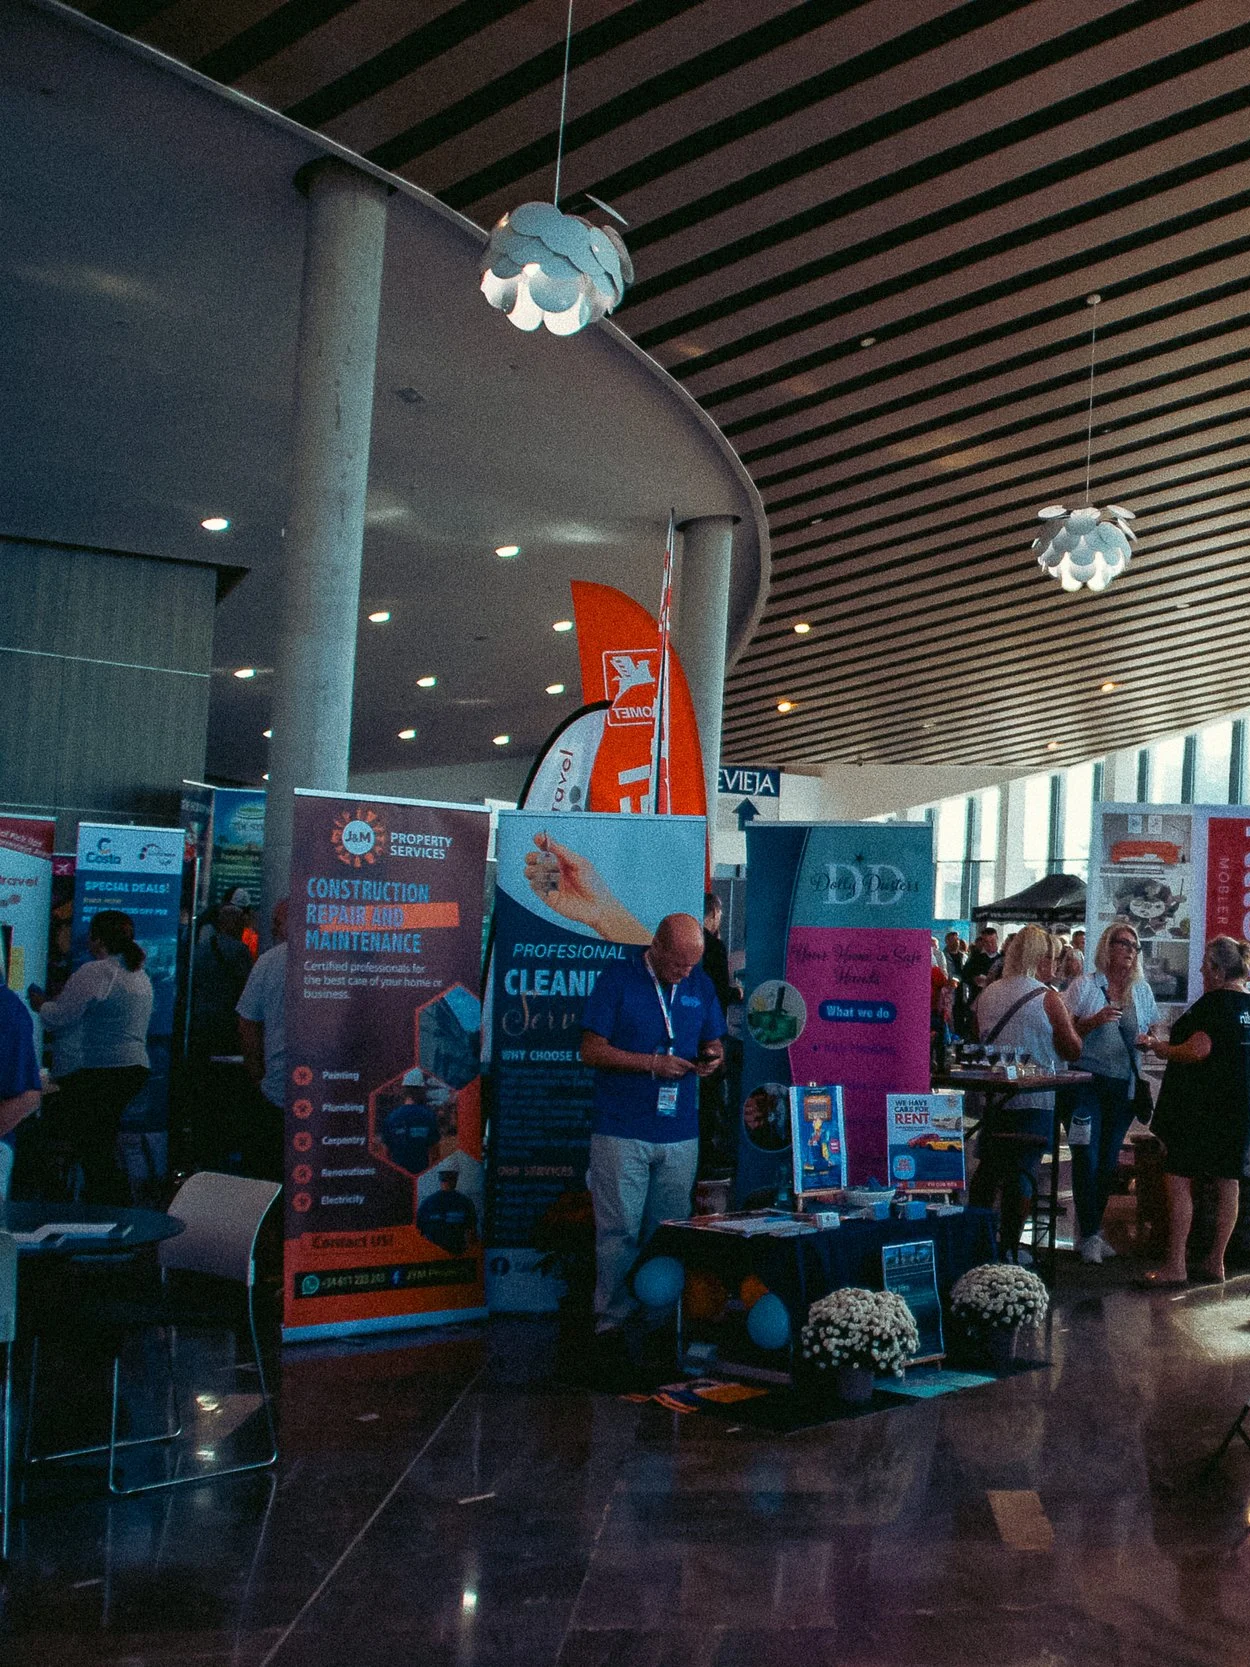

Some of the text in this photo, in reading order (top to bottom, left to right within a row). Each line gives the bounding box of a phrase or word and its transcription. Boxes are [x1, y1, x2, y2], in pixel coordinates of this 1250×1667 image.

[345, 830, 371, 844] J&M
[390, 831, 453, 848] PROPERTY
[86, 852, 121, 865] Costa
[390, 845, 446, 860] SERVICES
[85, 881, 170, 893] SPECIAL DEALS!
[307, 876, 430, 903] CONSTRUCTION
[306, 903, 405, 927] REPAIR AND
[305, 929, 422, 953] MAINTENANCE
[512, 942, 627, 960] PROFESIONAL
[303, 960, 426, 974] Certified professionals for
[303, 975, 443, 990] the best care of your home or
[504, 969, 602, 997] CLEANI
[303, 989, 351, 1000] business.
[826, 1004, 890, 1019] What we do
[501, 1049, 526, 1062] WHY
[529, 1049, 574, 1063] CHOOSE
[322, 1070, 360, 1082] Painting
[322, 1102, 365, 1114] Plumbing
[894, 1113, 930, 1125] RENT
[321, 1135, 366, 1147] Carpentry
[321, 1167, 377, 1177] Renovations
[320, 1194, 365, 1206] Electricity
[312, 1234, 367, 1249] Contact
